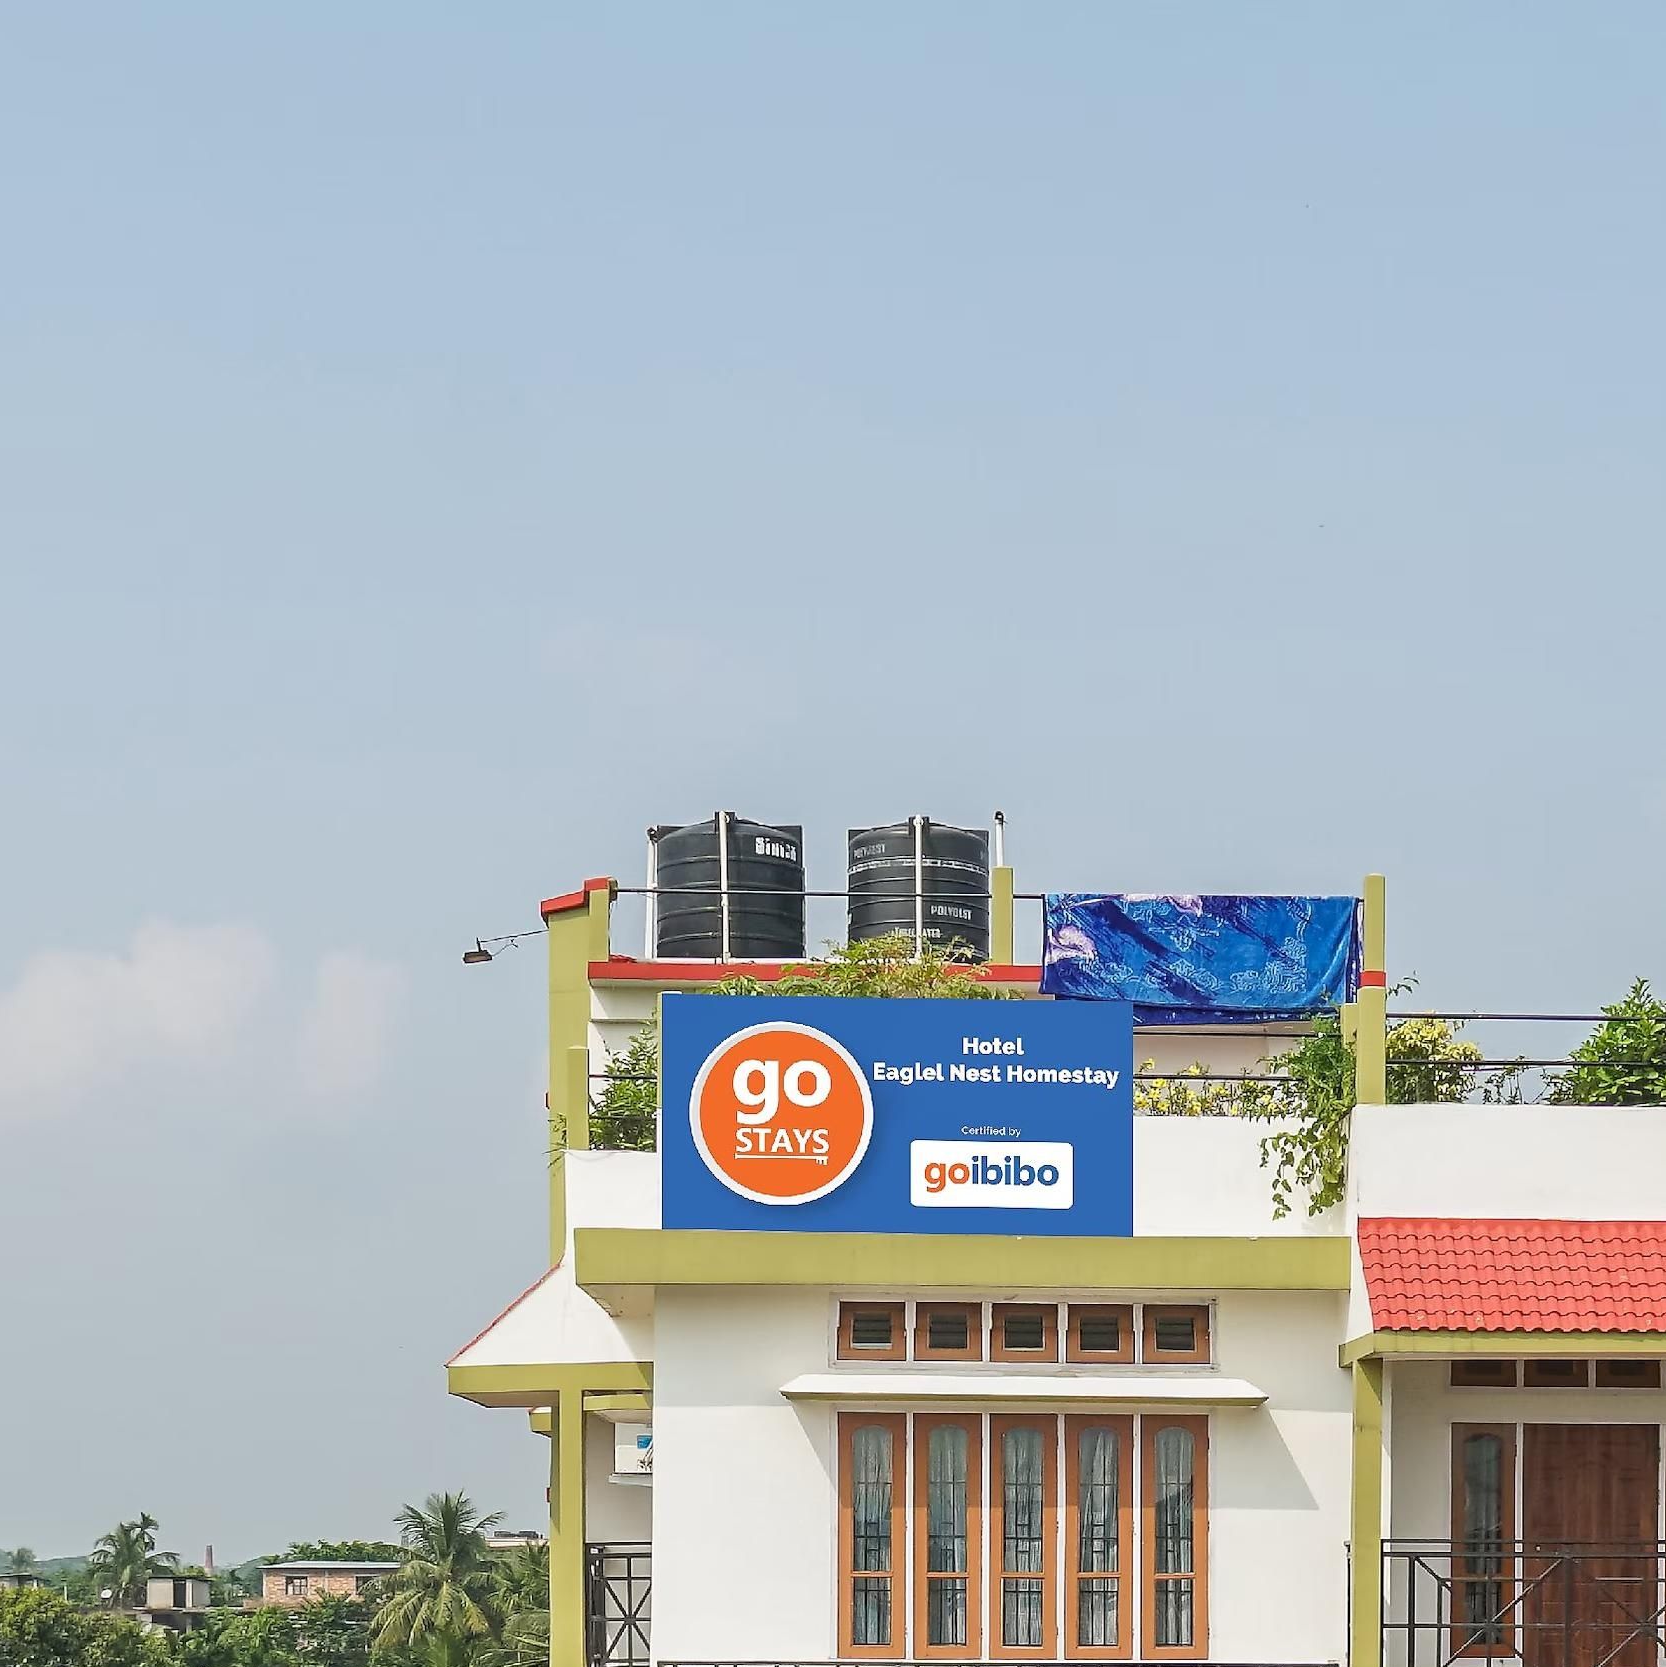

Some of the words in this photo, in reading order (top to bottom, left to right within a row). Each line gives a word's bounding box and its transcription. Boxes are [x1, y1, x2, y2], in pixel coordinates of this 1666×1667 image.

[962, 1037, 1025, 1055] Hotel
[873, 1062, 945, 1085] Eaglel
[949, 1064, 1002, 1083] Nest
[1006, 1065, 1120, 1090] Homestay
[732, 1058, 832, 1125] go
[735, 1128, 830, 1154] STAYS
[961, 1126, 1006, 1137] Certified
[1008, 1126, 1022, 1138] by
[924, 1156, 1060, 1193] goibibo
